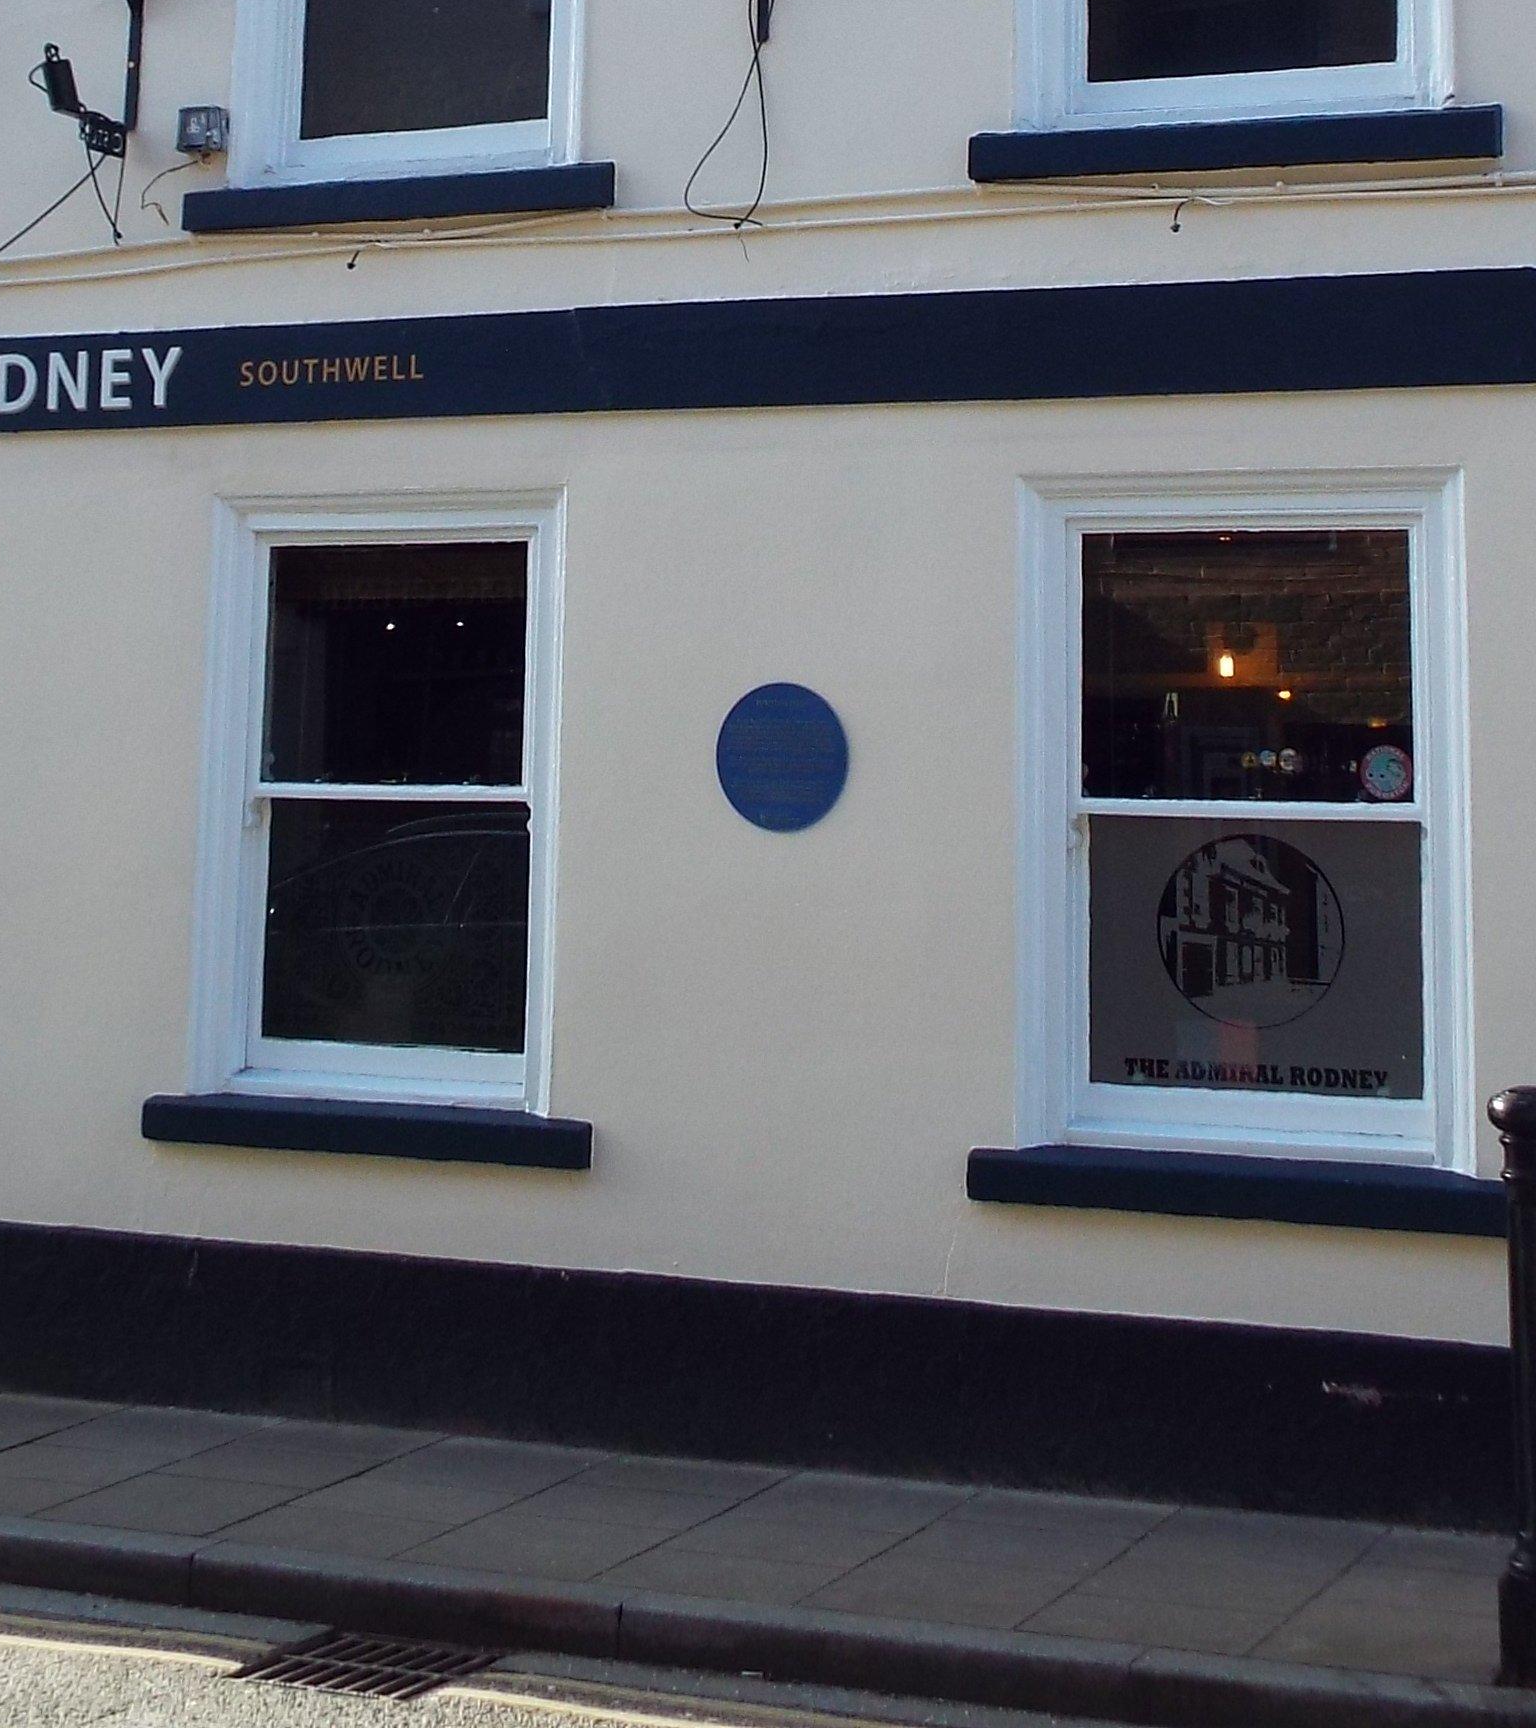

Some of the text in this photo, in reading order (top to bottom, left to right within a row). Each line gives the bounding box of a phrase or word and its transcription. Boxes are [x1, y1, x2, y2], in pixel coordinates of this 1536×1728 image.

[240, 354, 424, 389] SOUTHWELL
[1125, 1057, 1388, 1090] THE ADMIRAL RODNEY
